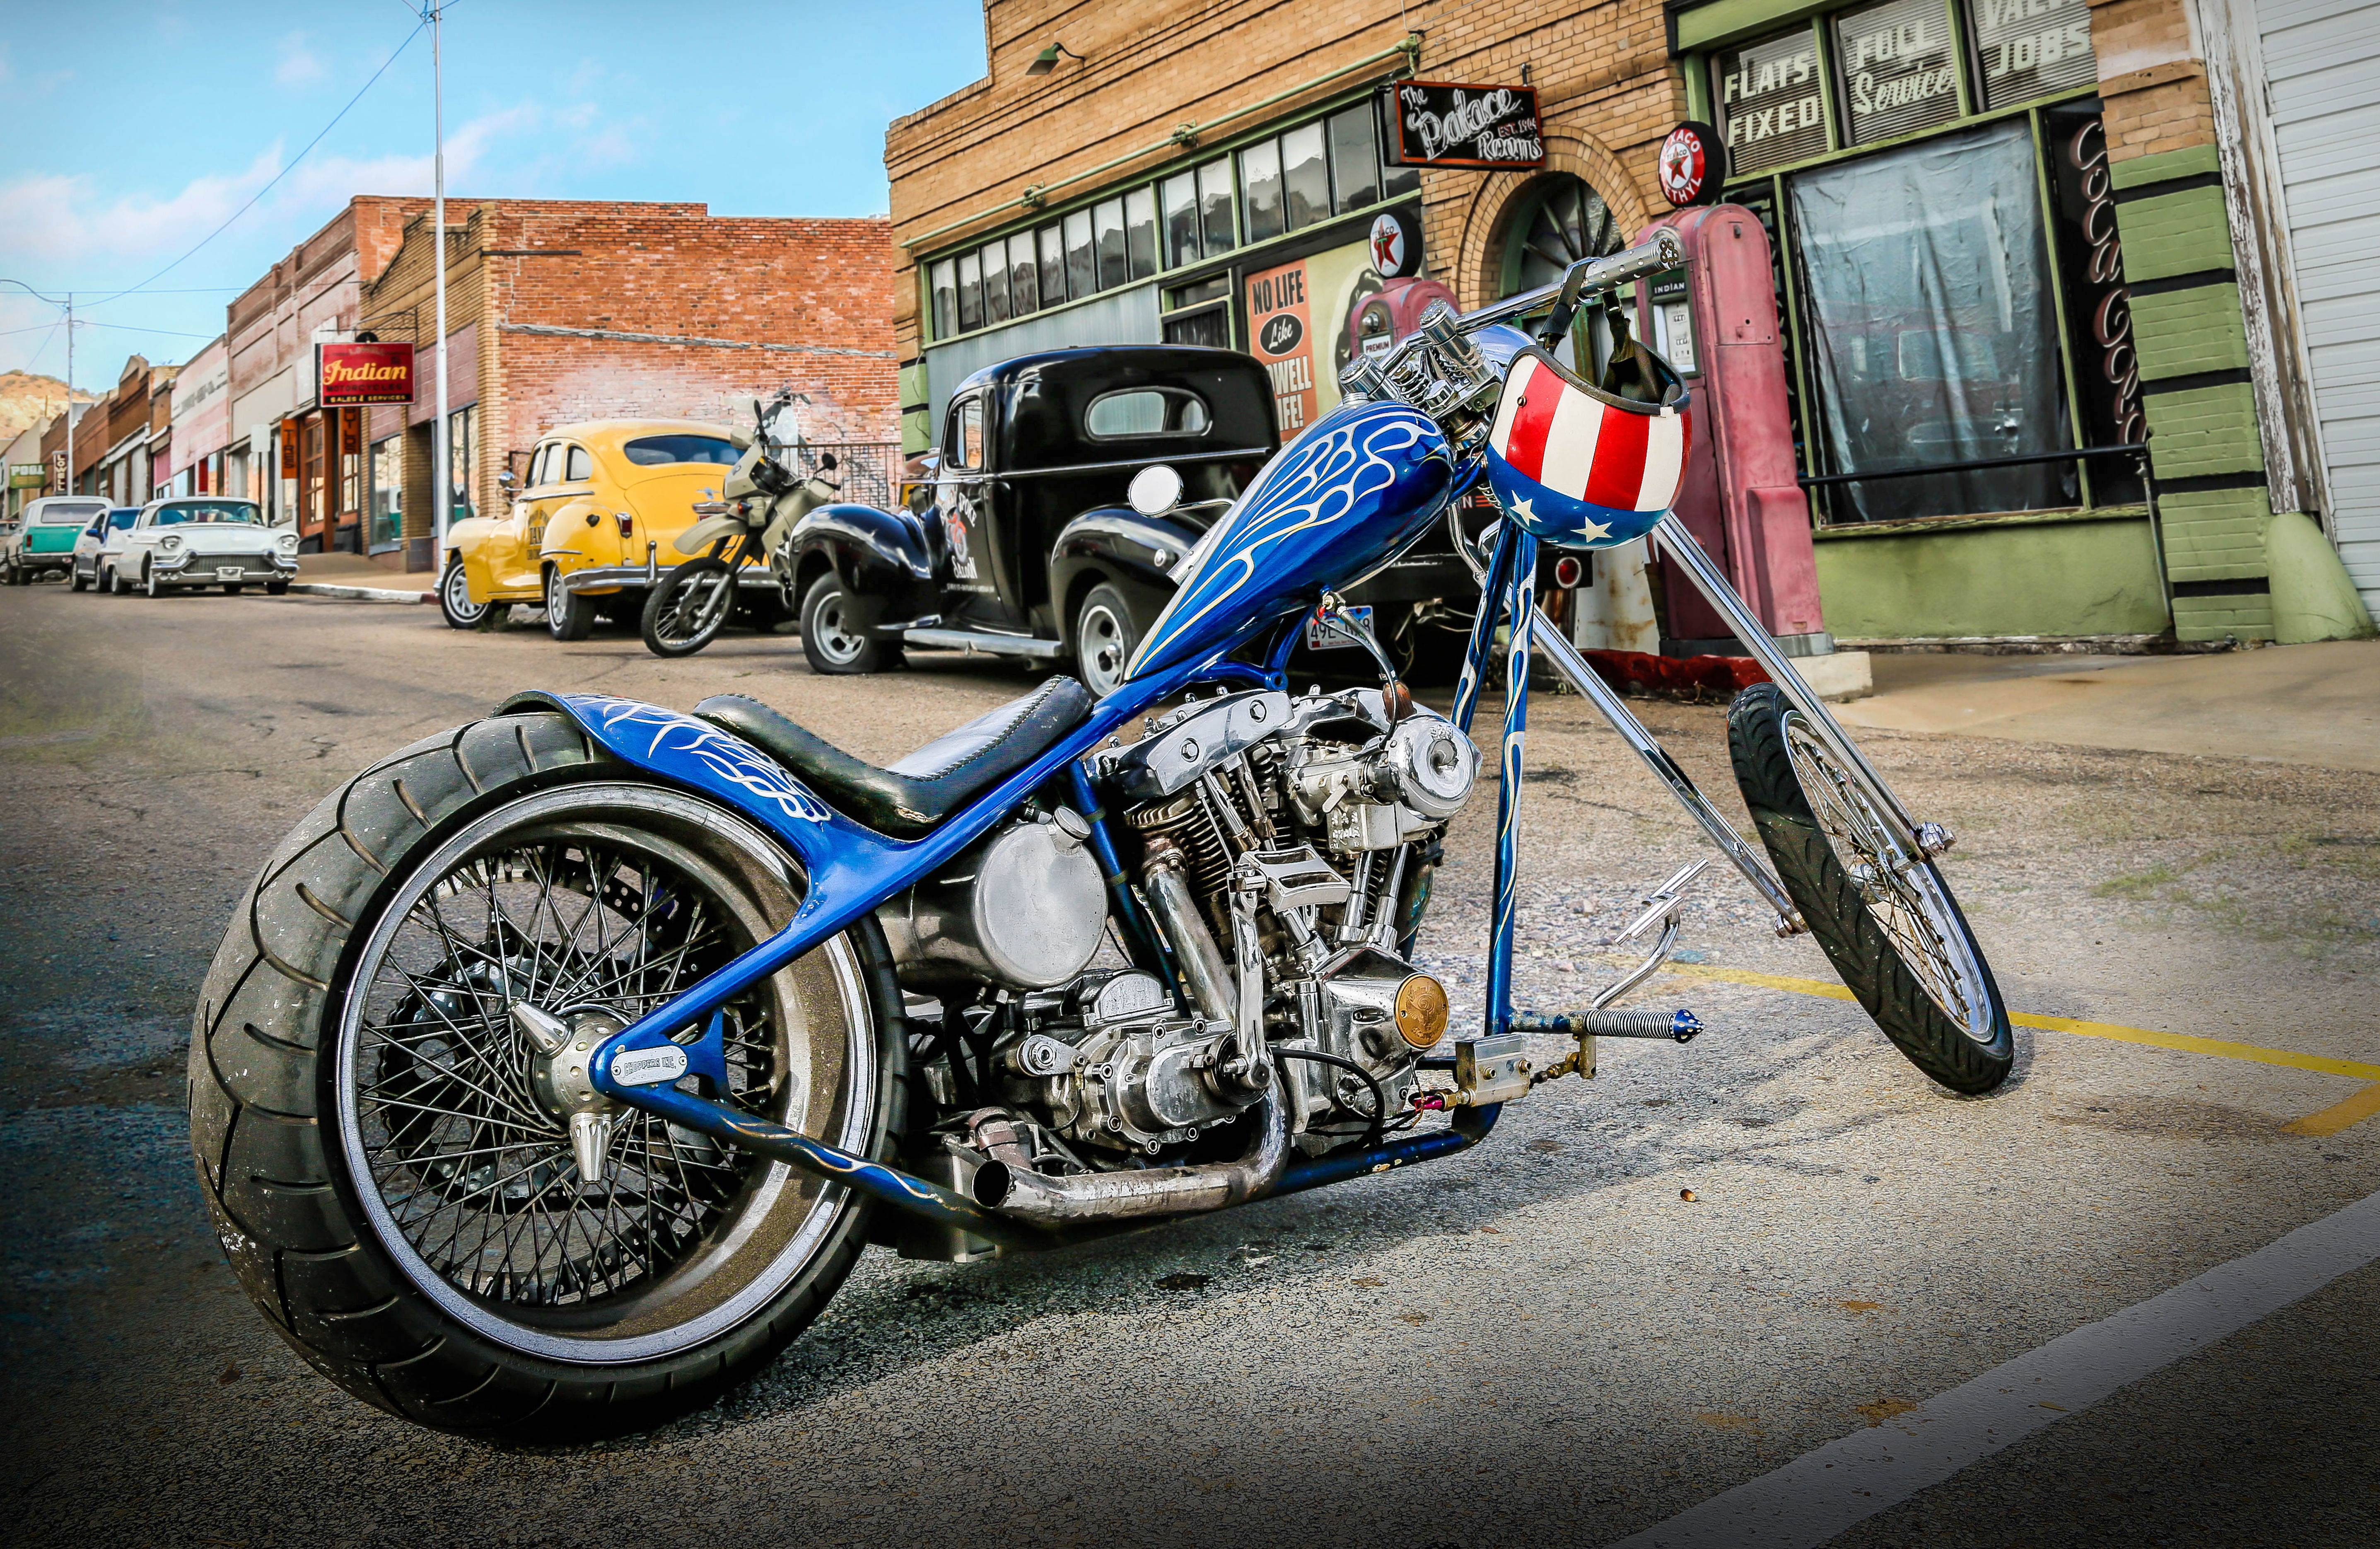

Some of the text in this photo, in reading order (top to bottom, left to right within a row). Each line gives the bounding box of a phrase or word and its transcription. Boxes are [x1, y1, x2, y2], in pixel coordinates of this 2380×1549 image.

[1856, 19, 1936, 69] FULL
[1990, 20, 2090, 77] JOBS
[1724, 51, 1810, 104] FLATS
[1853, 61, 1956, 115] Service
[1400, 86, 1428, 109] The
[1407, 89, 1521, 161] Palace
[1728, 96, 1819, 147] FIXED
[1468, 130, 1543, 161] Rooms
[1665, 178, 1702, 202] ETHYL
[1252, 269, 1304, 315] NO LIFE
[1654, 282, 1685, 294] INDIAN
[1269, 318, 1293, 350] Like
[1366, 341, 1389, 353] PREMIUM
[323, 360, 406, 385] Indian
[326, 384, 402, 392] MOTORCYCLES
[1277, 393, 1303, 431] IFE!
[55, 454, 68, 491] LOWELL
[958, 492, 977, 528] SPOKE
[951, 555, 978, 579] SALOON
[623, 1058, 661, 1076] CHOPPERS
